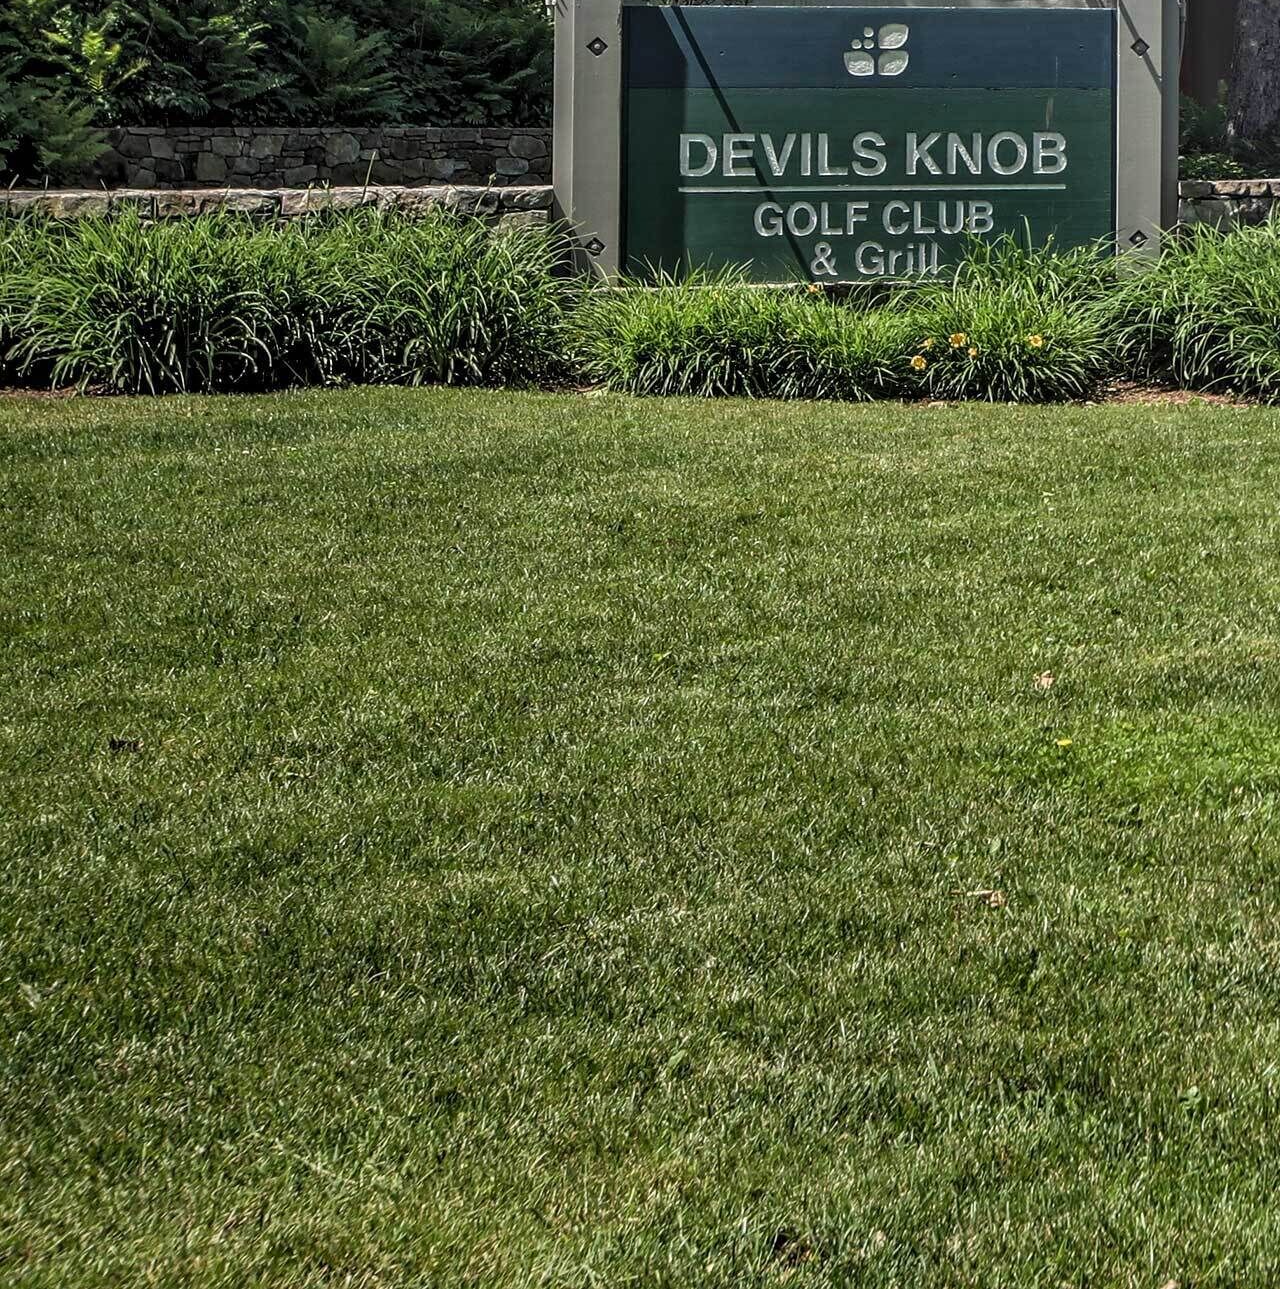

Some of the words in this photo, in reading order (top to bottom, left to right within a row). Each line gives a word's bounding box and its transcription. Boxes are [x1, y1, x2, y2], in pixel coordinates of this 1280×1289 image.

[678, 130, 888, 177] DEVILS
[905, 130, 1068, 176] KNOB
[753, 200, 870, 237] GOLF
[881, 199, 995, 235] CLUB
[809, 241, 839, 276] &
[854, 240, 939, 275] Grill
